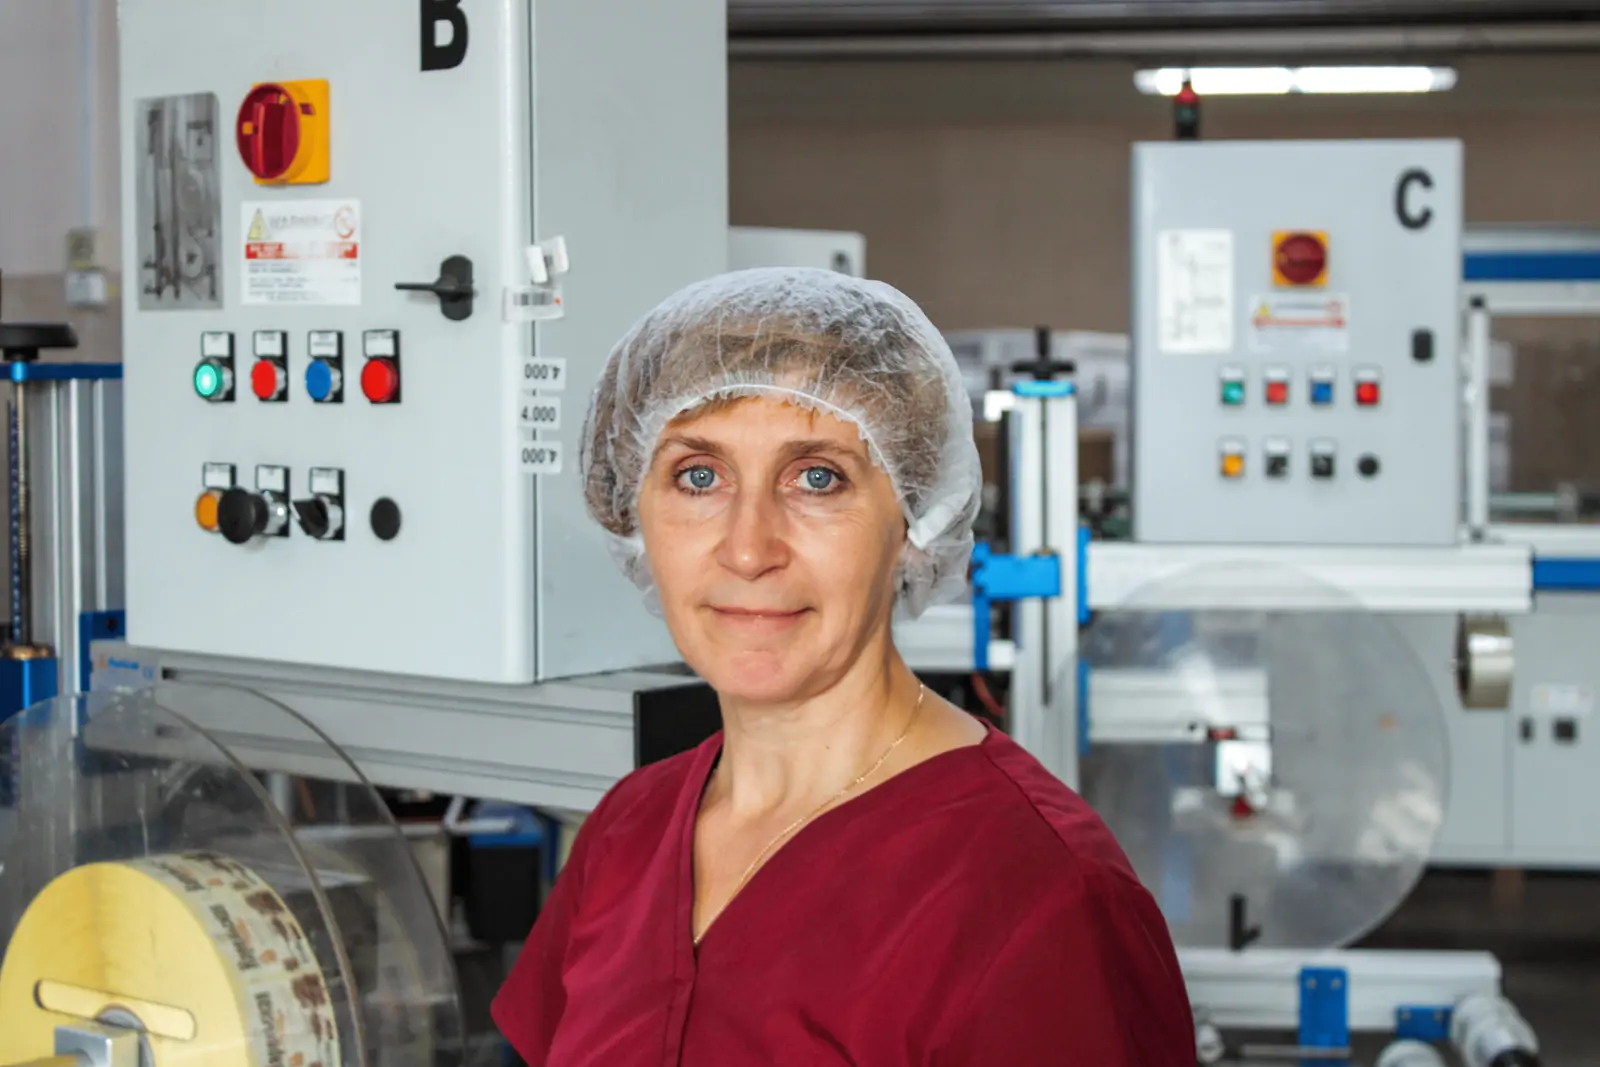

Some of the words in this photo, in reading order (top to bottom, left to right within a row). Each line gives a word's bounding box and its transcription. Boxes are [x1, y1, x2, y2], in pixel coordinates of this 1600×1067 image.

[420, 0, 469, 71] B
[1395, 167, 1433, 231] C
[520, 405, 556, 422] 4.000
